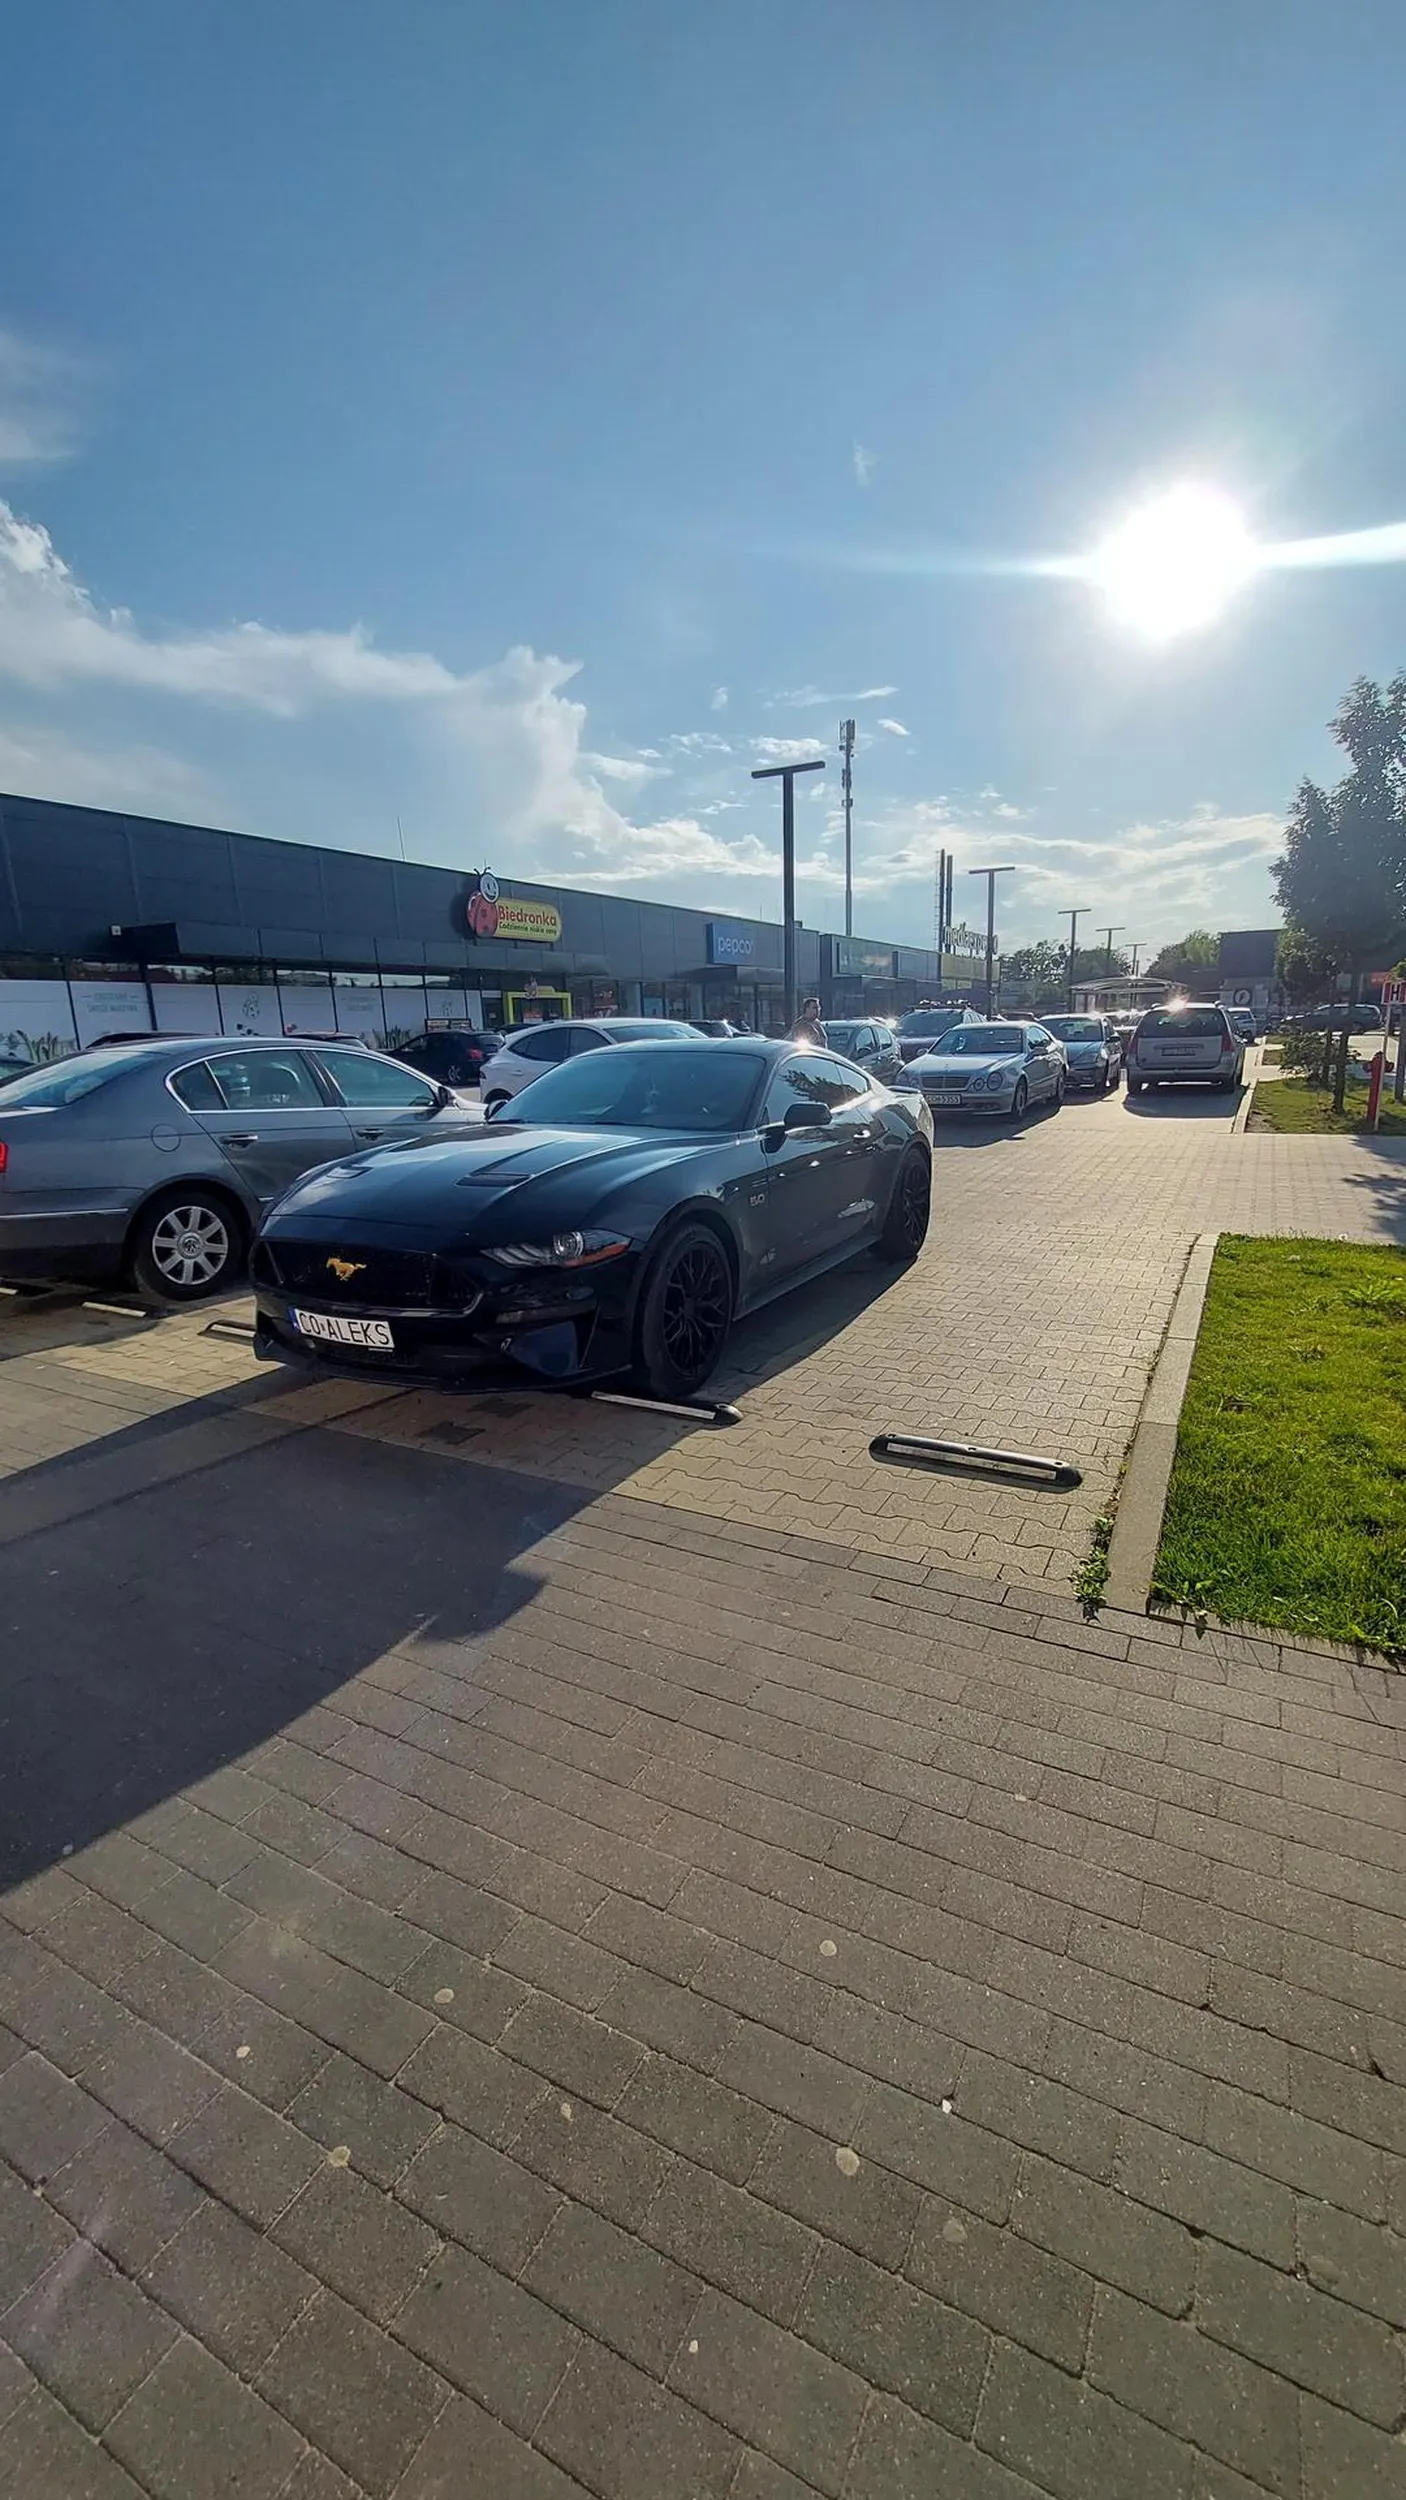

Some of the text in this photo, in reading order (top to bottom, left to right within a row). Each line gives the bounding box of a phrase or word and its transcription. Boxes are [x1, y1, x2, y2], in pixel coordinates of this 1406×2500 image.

[498, 904, 557, 926] Biedronka
[1390, 983, 1401, 1001] H
[326, 1318, 389, 1345] ALEKS
